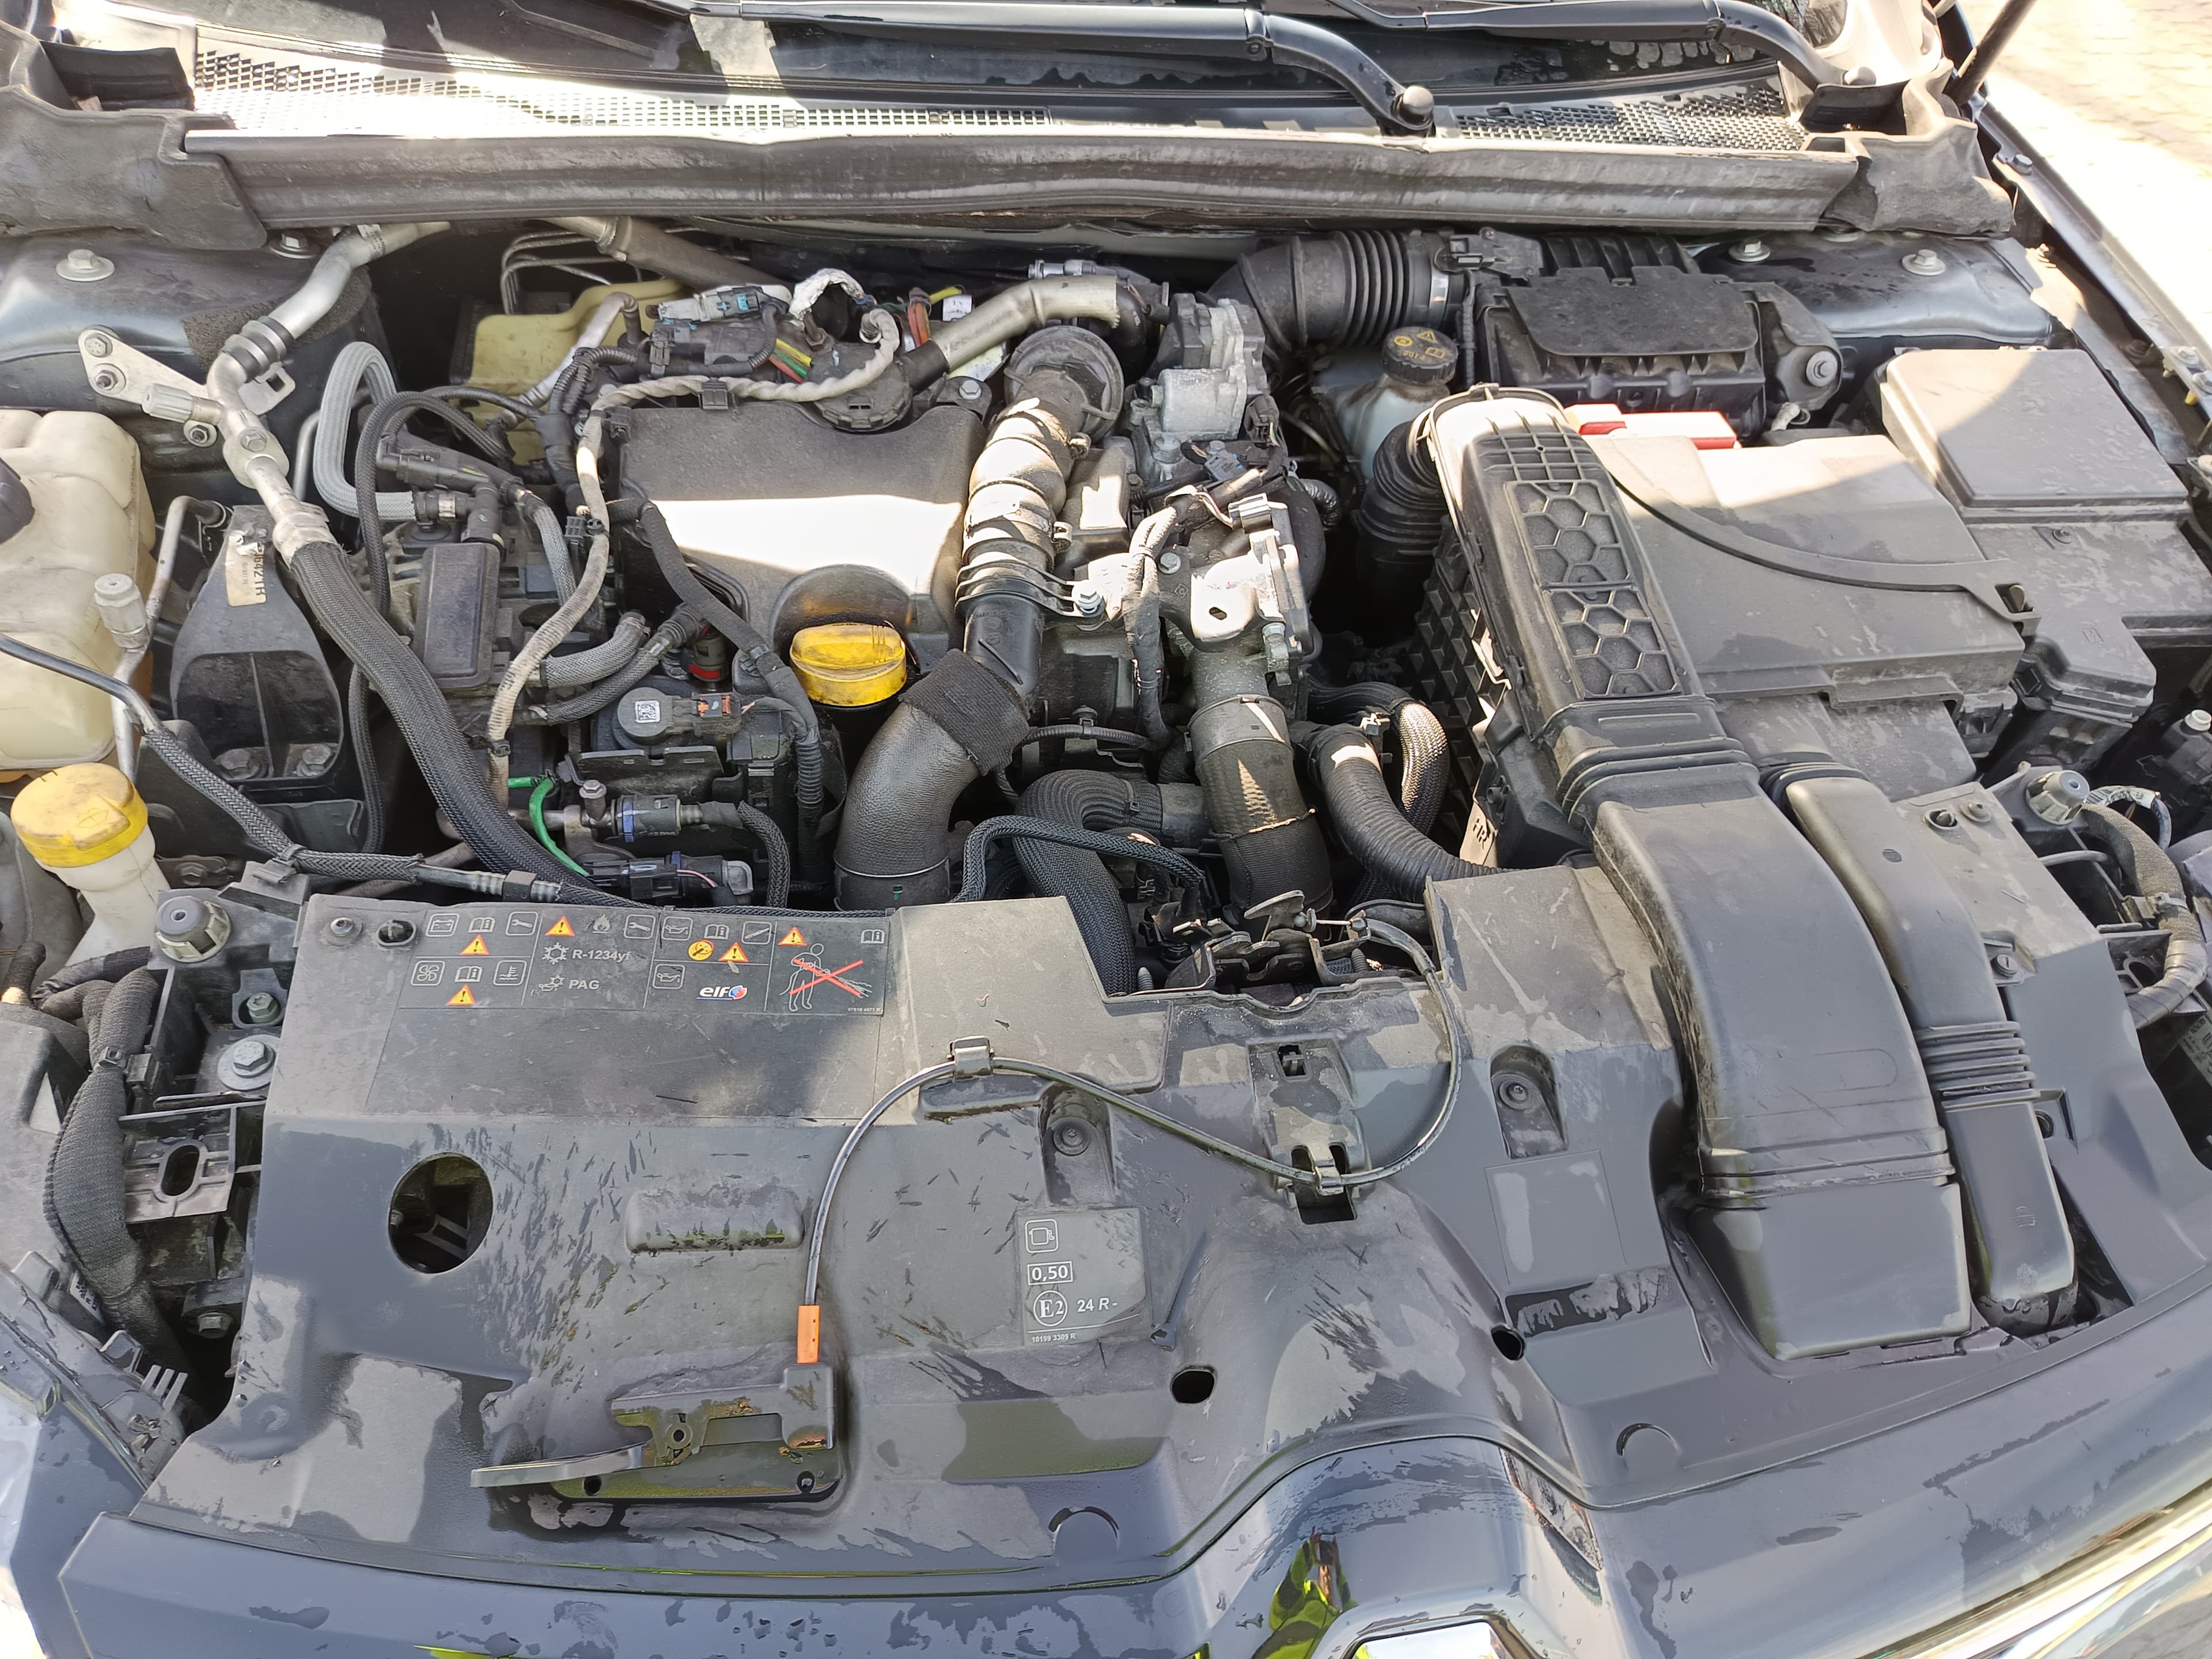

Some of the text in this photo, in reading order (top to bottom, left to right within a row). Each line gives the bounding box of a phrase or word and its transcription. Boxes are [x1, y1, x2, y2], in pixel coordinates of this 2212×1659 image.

[1403, 350, 1419, 359] DOT
[572, 949, 632, 963] R-1234yf
[569, 980, 600, 990] PAG
[699, 986, 730, 997] elf
[1032, 1266, 1069, 1282] 0,50
[1077, 1300, 1094, 1312] 24
